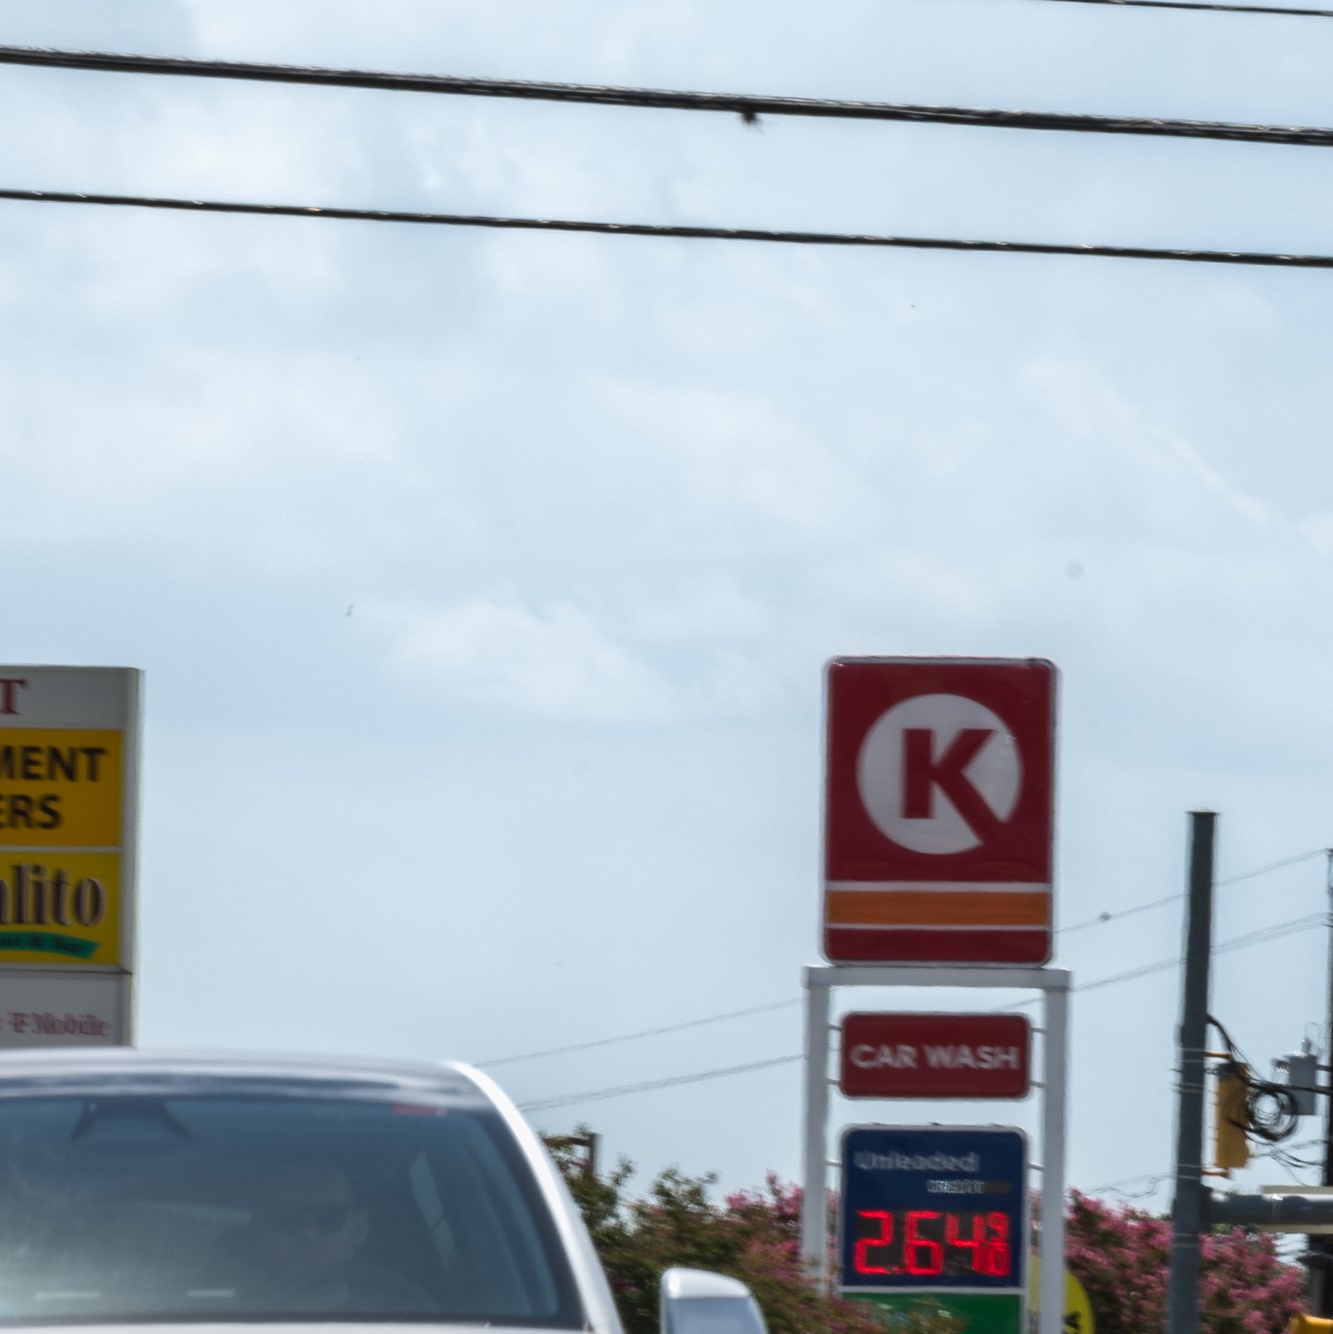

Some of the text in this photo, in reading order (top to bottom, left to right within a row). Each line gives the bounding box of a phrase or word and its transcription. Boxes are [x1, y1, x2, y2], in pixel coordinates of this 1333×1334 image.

[849, 1044, 1022, 1071] CAR WASH
[854, 1150, 981, 1172] Unleaded
